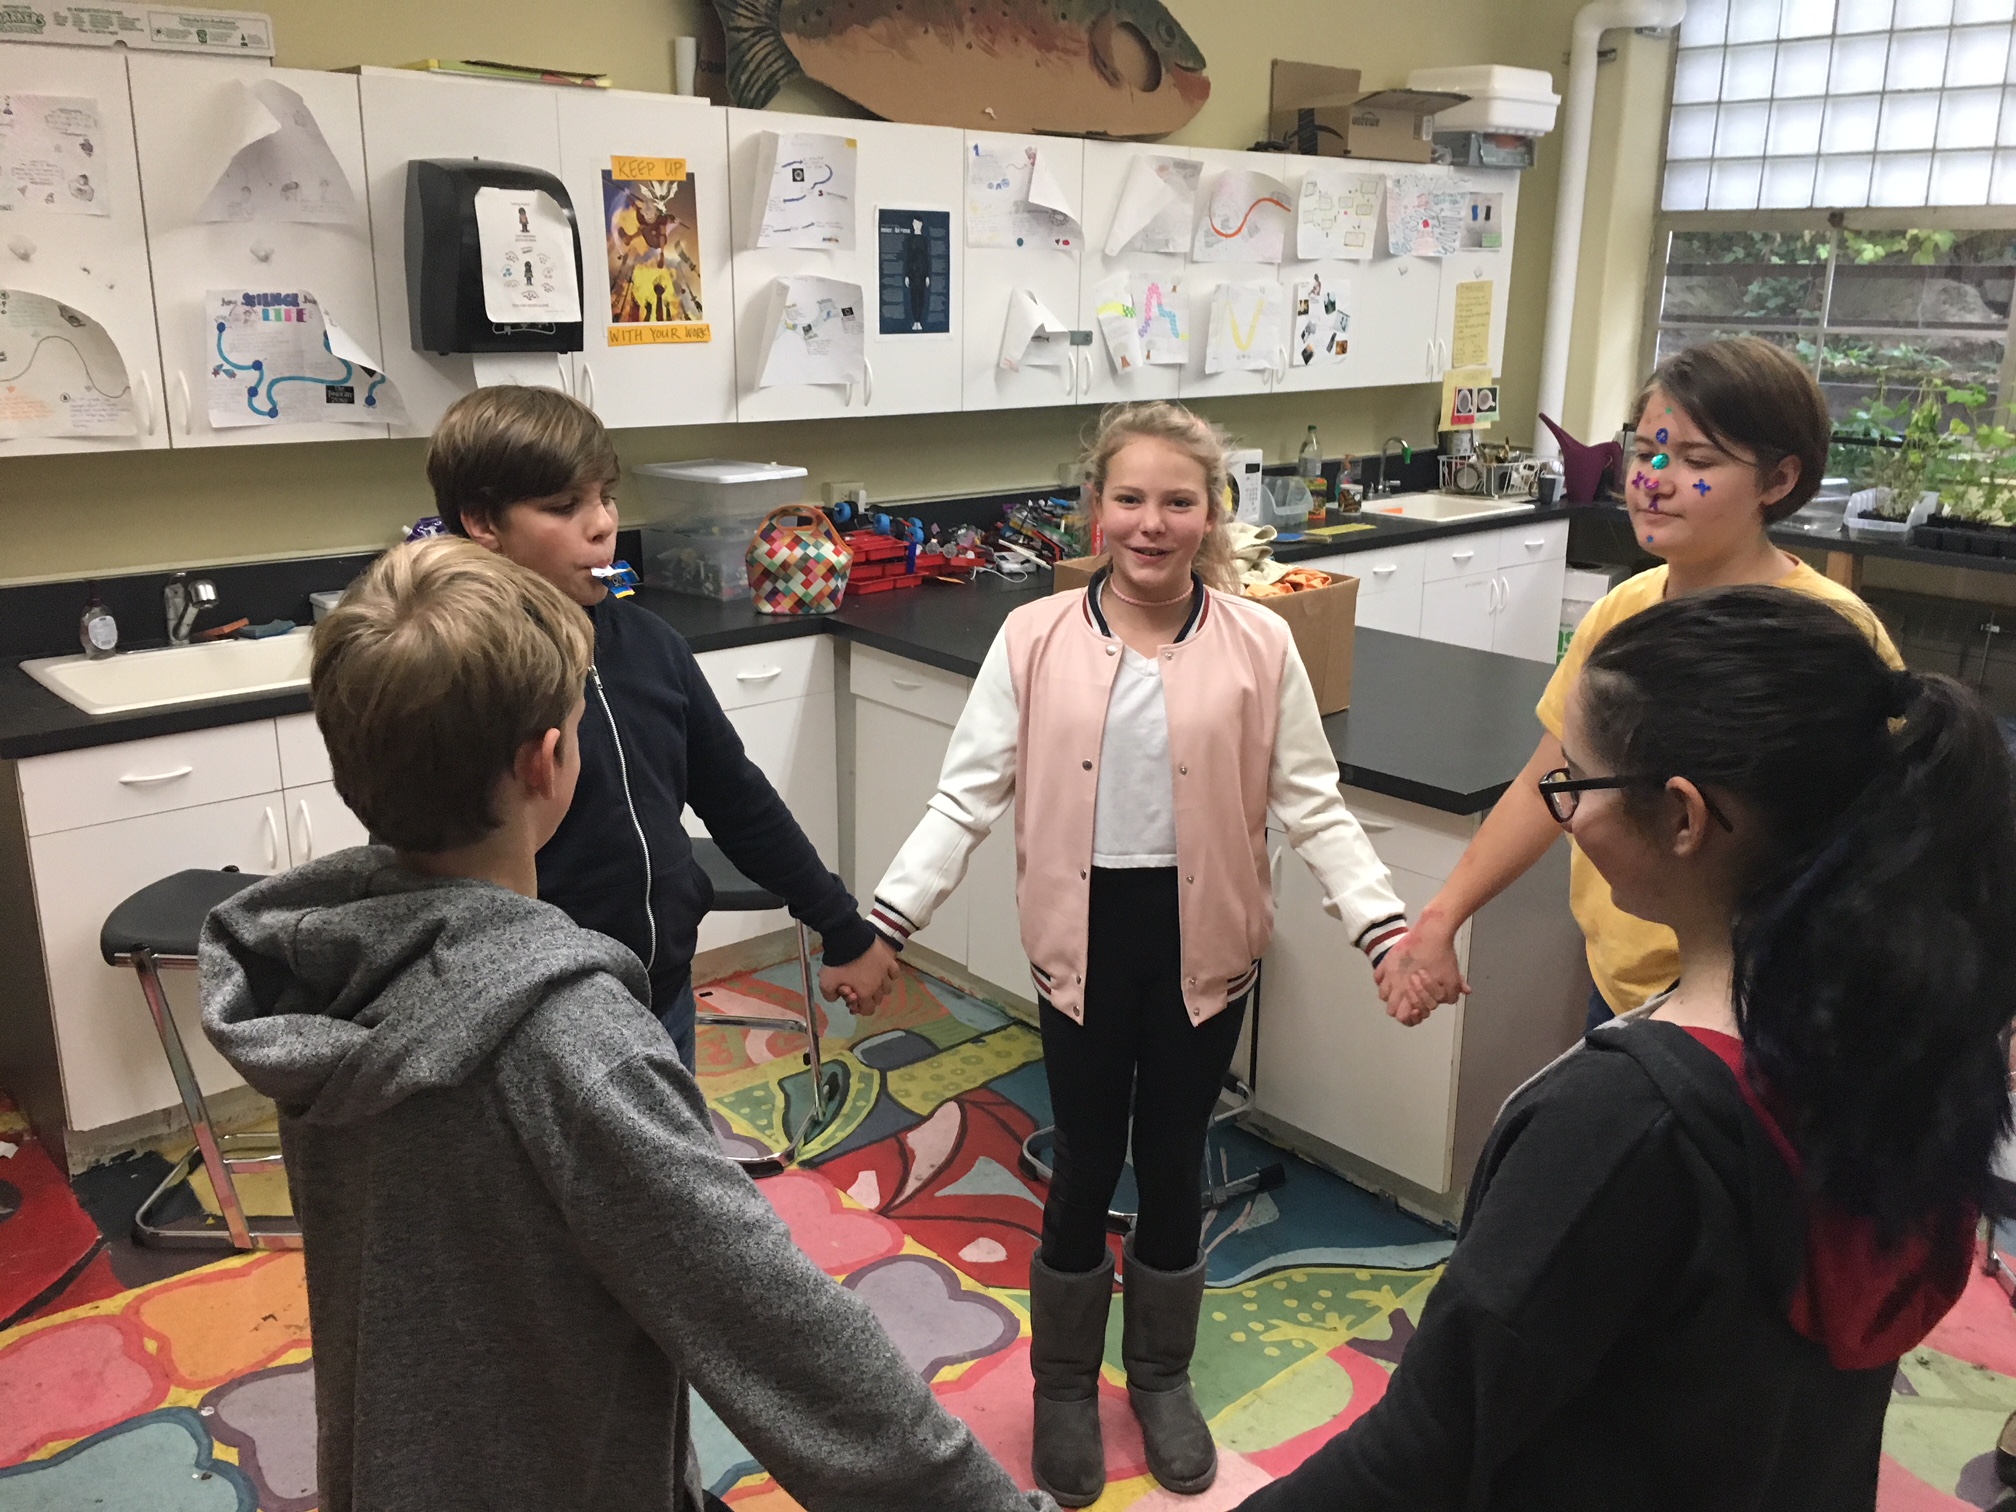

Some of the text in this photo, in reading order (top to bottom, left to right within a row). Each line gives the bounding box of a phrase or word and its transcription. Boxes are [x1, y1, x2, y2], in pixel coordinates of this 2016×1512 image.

[617, 159, 683, 178] KEEP UP
[262, 308, 306, 322] LIFE
[609, 324, 711, 343] WITH YOUR WORK!
